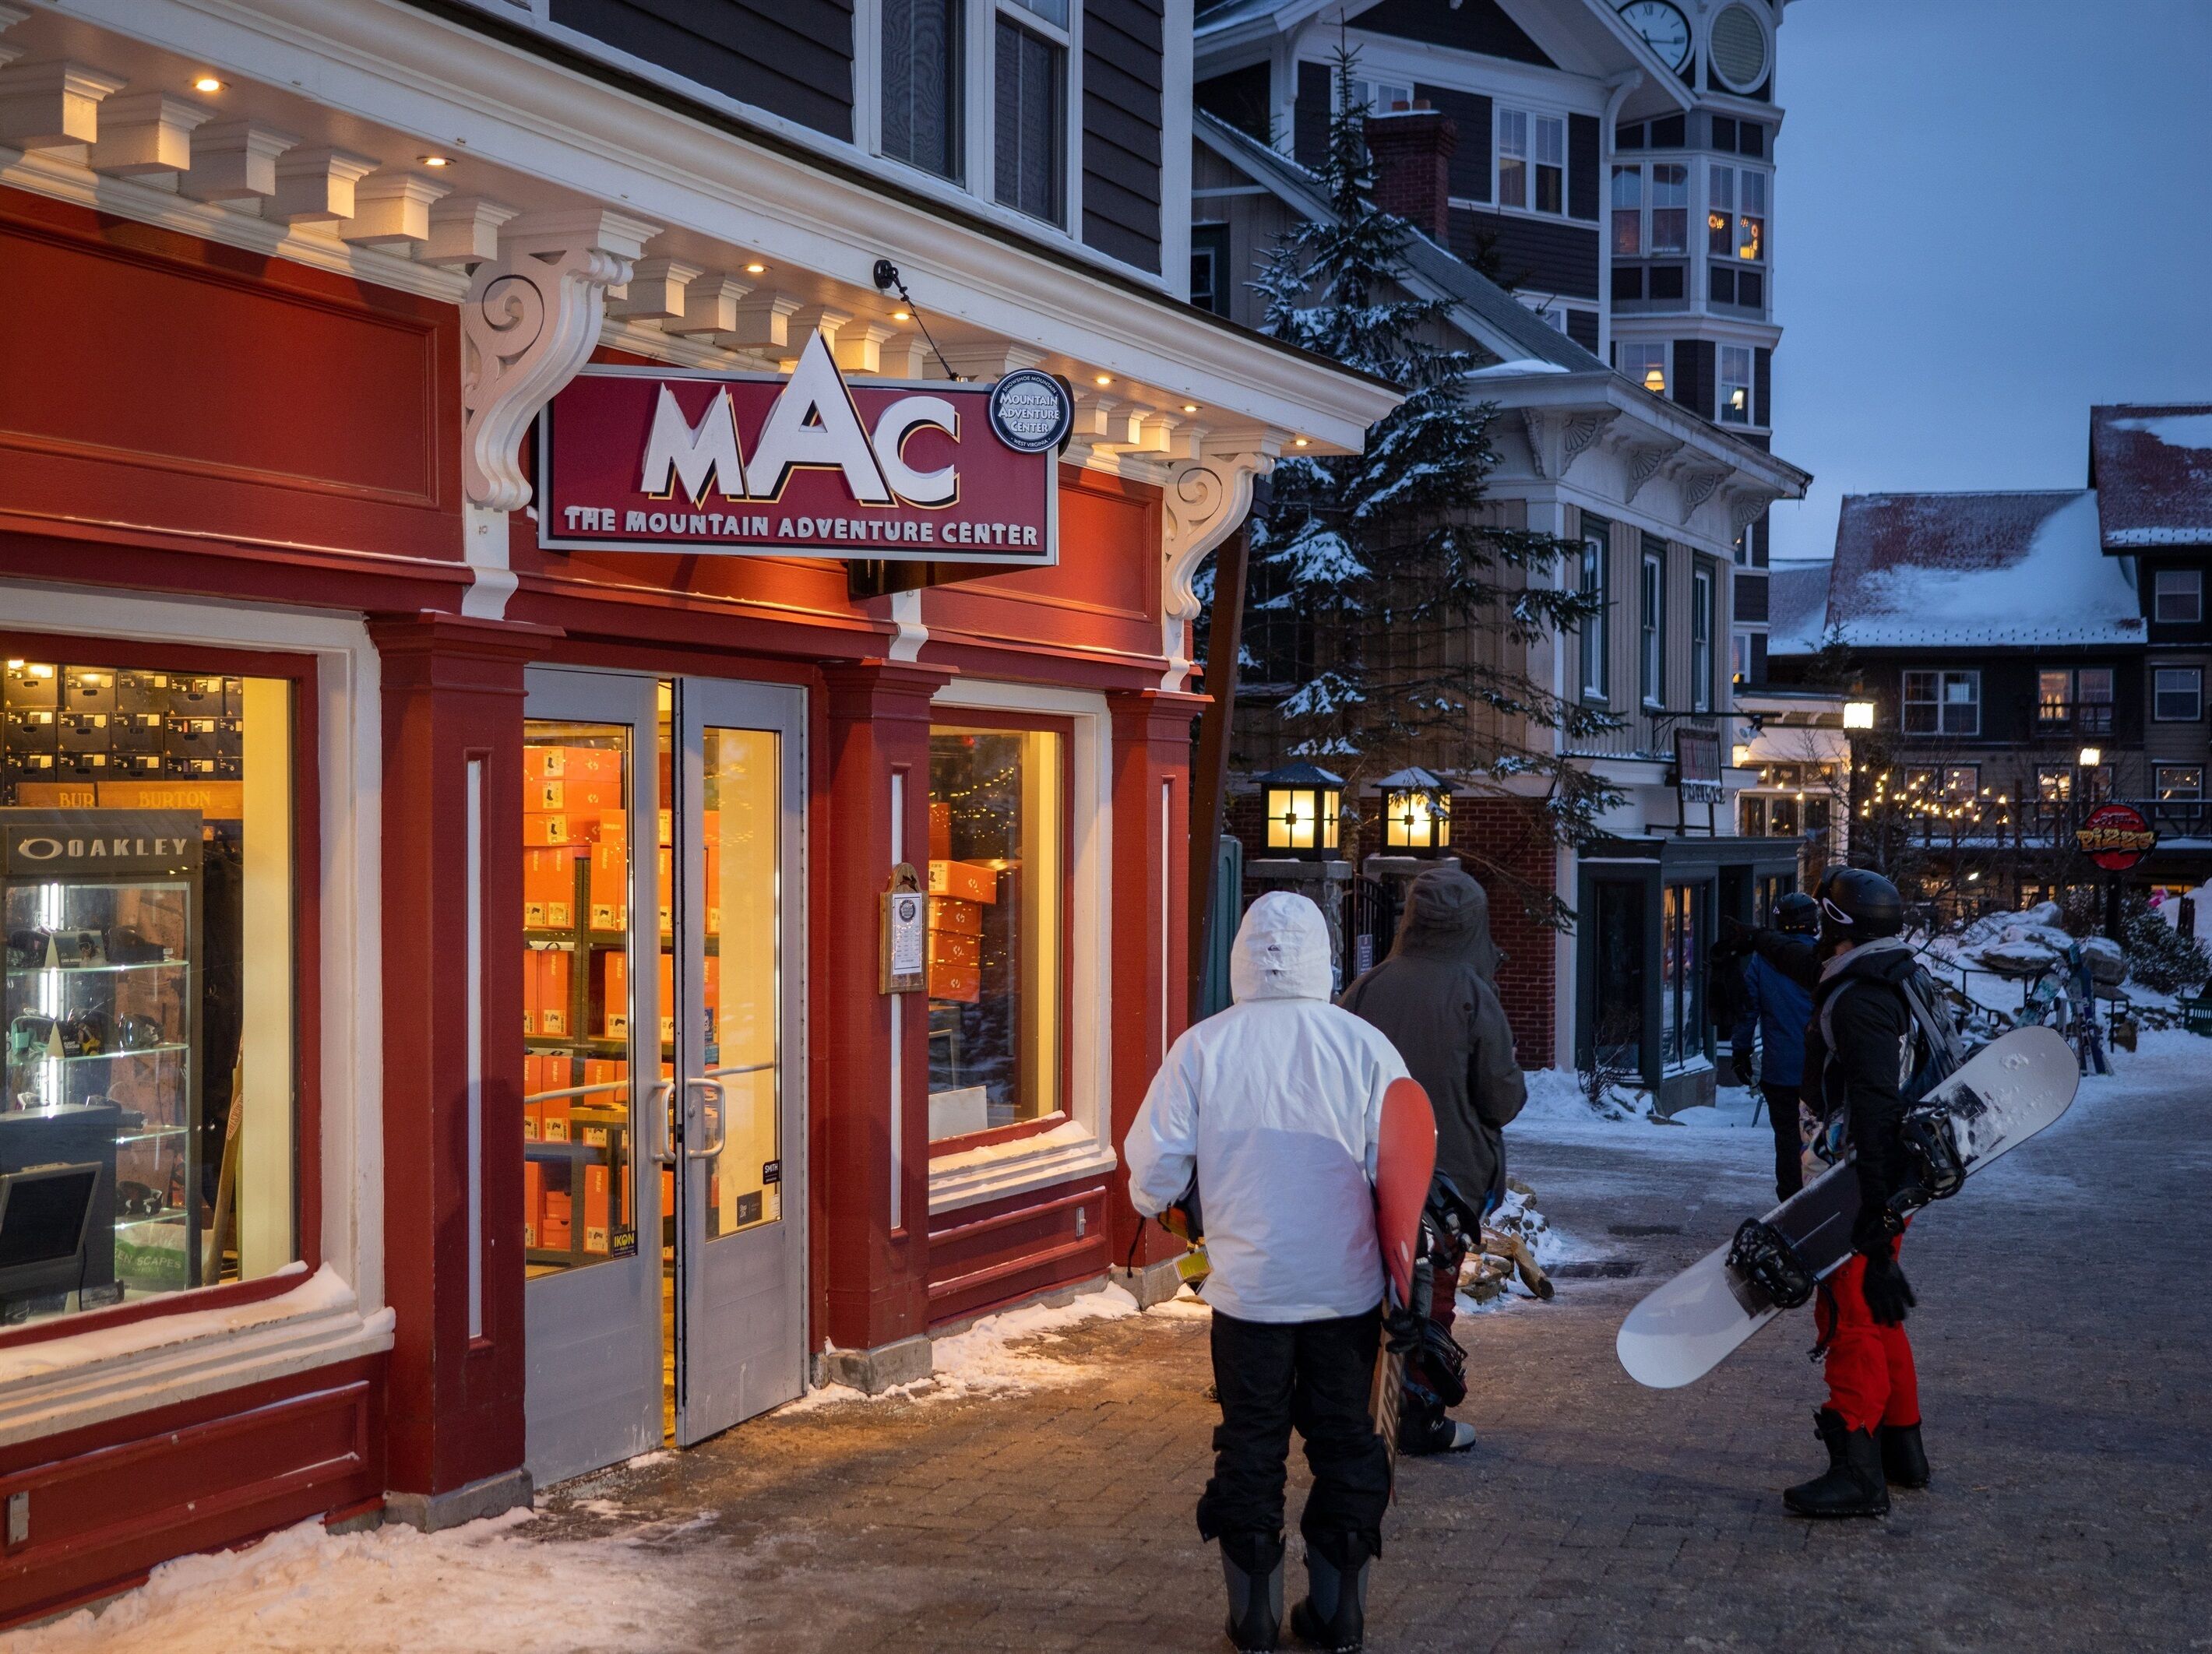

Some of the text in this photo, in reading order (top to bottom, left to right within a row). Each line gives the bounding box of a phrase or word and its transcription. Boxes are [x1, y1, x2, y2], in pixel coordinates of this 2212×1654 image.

[1002, 375, 1057, 393] SNOWSHOE MOUNTAIN
[999, 392, 1058, 406] MOUNTAIN
[640, 328, 960, 510] MAC
[998, 406, 1060, 421] ADVENTURE
[1010, 421, 1049, 434] CENTER
[1013, 438, 1048, 448] WEST VIRGINIA
[565, 506, 1037, 546] THE MOUNTAIN ADVENTURE CENTER
[58, 792, 95, 808] BUR
[139, 790, 211, 808] BURTON
[67, 838, 188, 857] OAKLEY
[764, 1163, 778, 1174] SMITH
[614, 1232, 635, 1248] IKON
[136, 1255, 182, 1269] SCAPES
